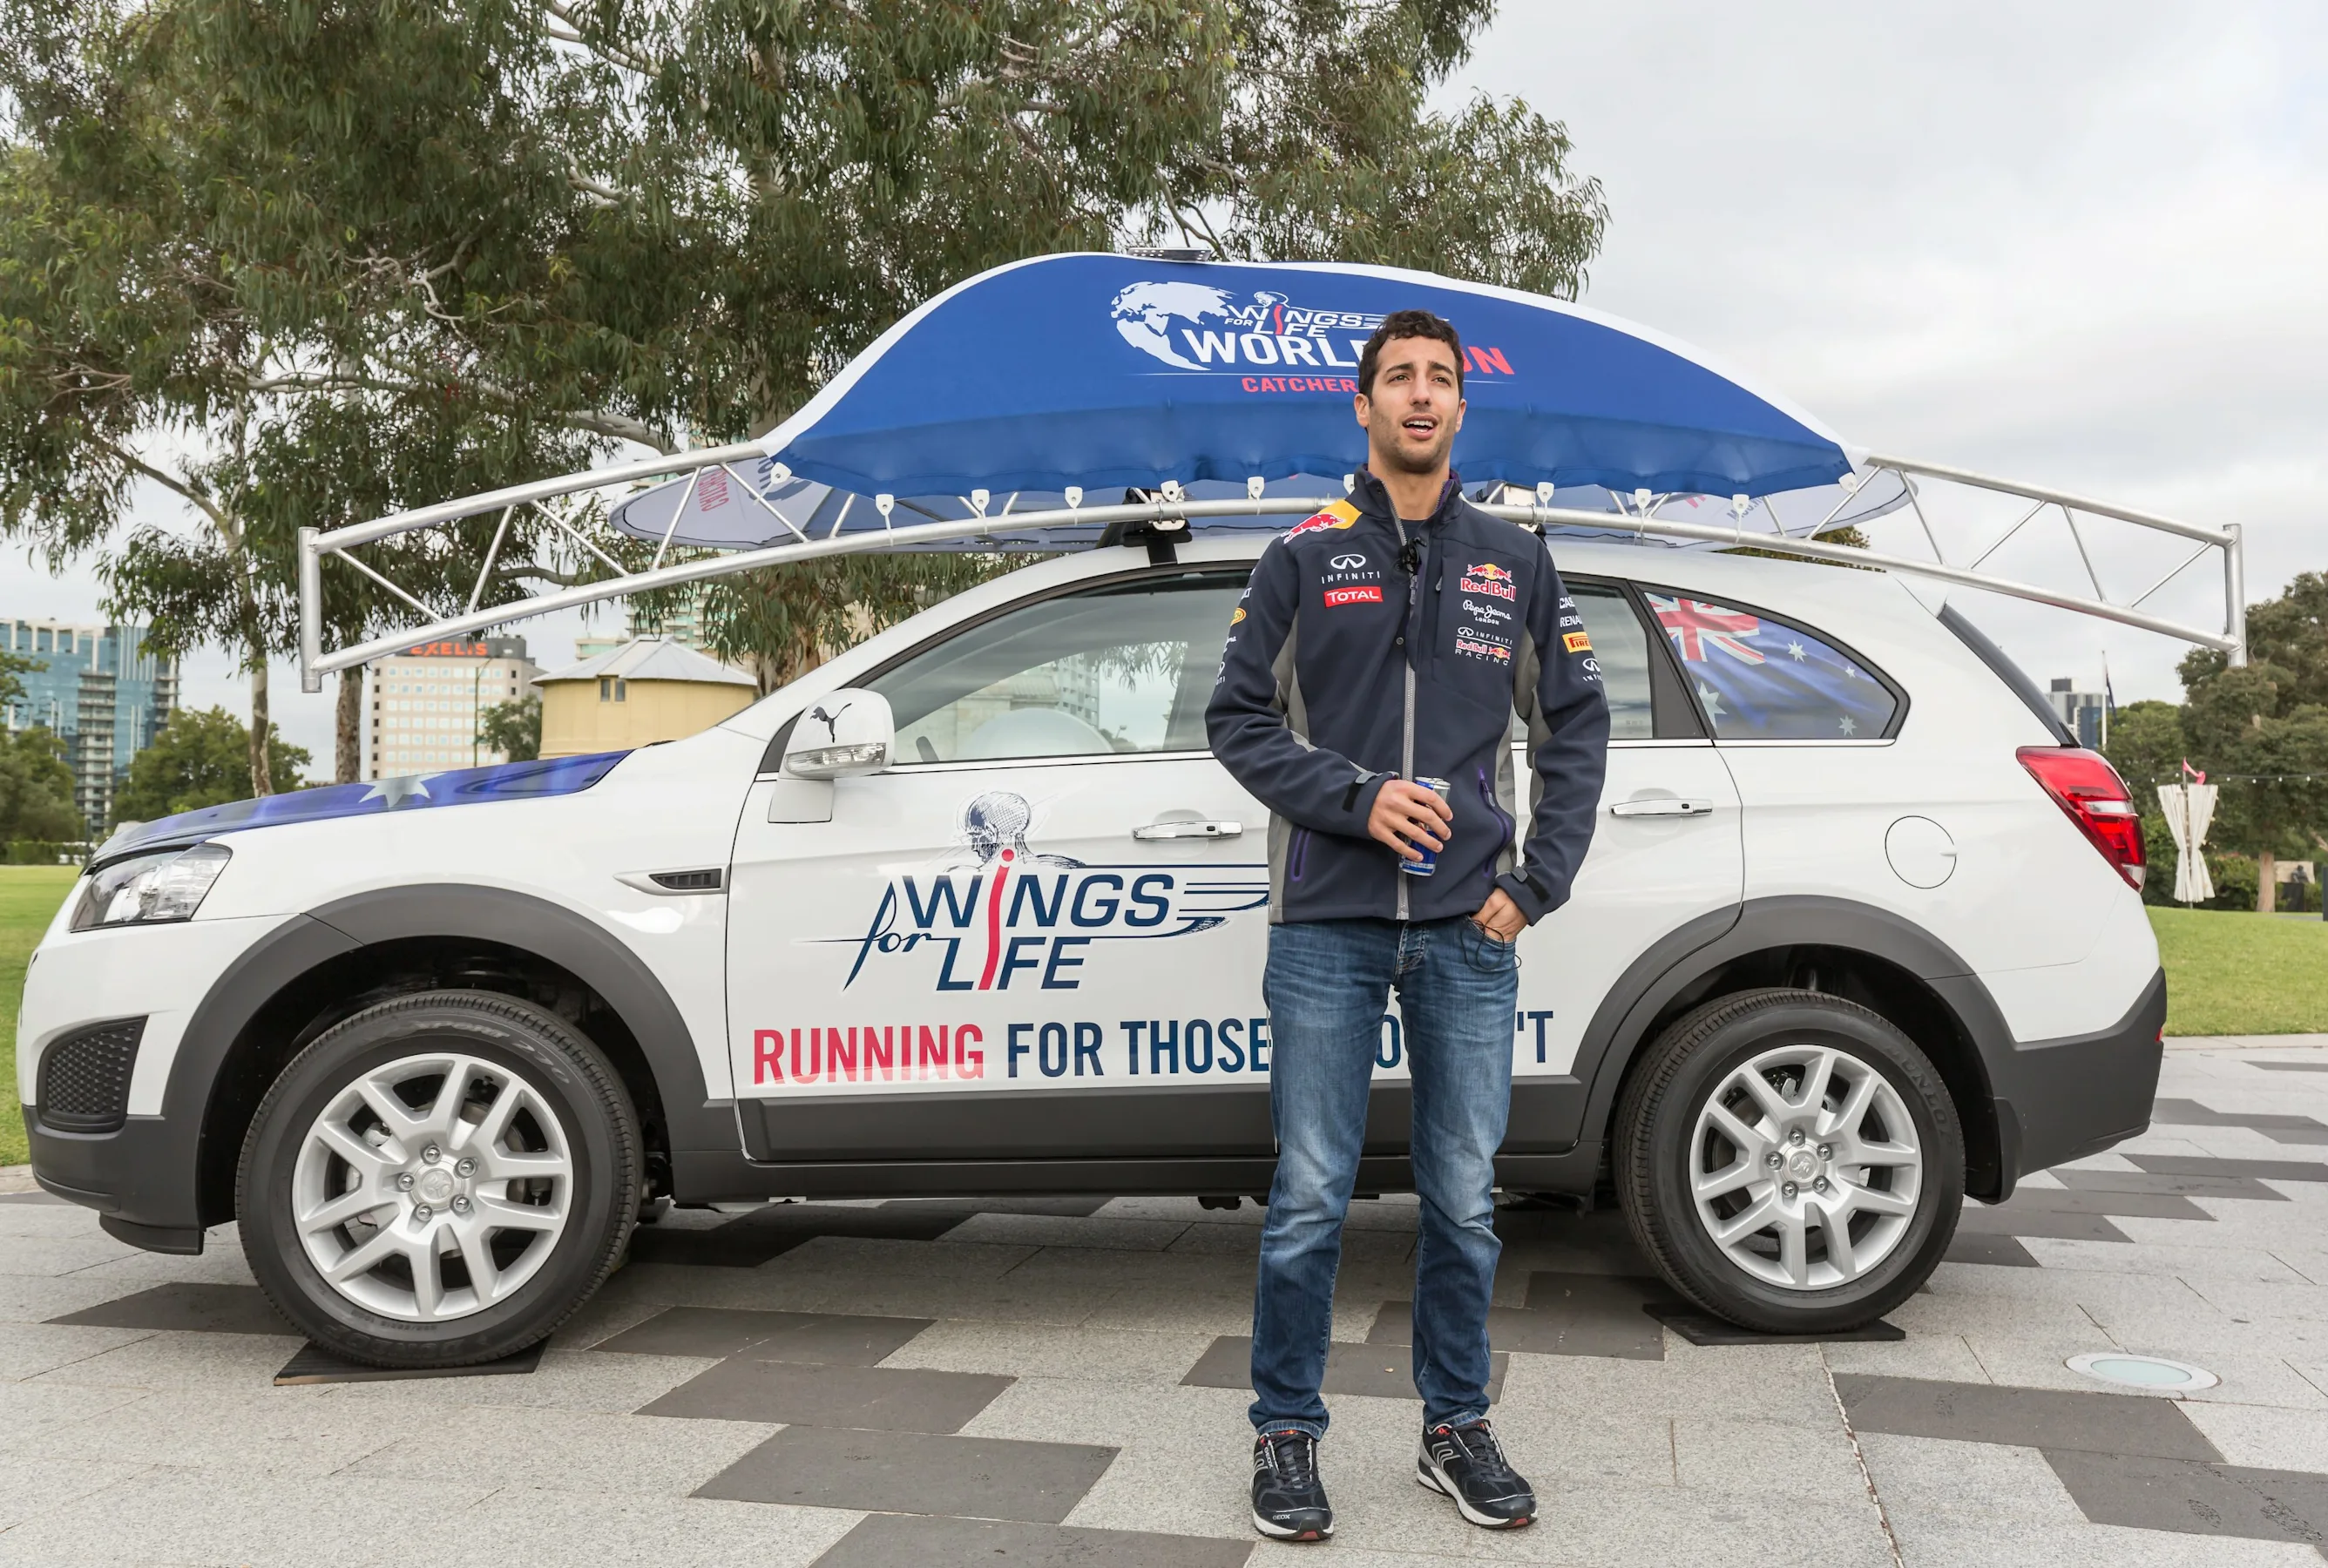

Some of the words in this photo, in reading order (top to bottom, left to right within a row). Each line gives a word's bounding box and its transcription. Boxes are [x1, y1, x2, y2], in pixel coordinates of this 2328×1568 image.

[1224, 317, 1254, 327] FOR
[1227, 303, 1363, 328] WINGS
[1253, 321, 1330, 338] LIFE
[1242, 377, 1359, 393] CATCHER
[1321, 571, 1380, 585] INFINITI
[1326, 590, 1379, 603] TOTAL
[1460, 578, 1490, 594] Red
[1491, 580, 1516, 602] Bull
[1463, 599, 1485, 616] Pepe
[1484, 605, 1512, 619] Jeans
[1560, 597, 1575, 609] CAS
[1475, 617, 1499, 625] LONDON
[1560, 615, 1583, 627] RENA
[1476, 631, 1513, 645] INFINITI
[1568, 635, 1591, 648] PIRE
[410, 641, 487, 657] EXELIS
[1457, 639, 1472, 651] Red
[1472, 642, 1488, 654] Bull
[1455, 648, 1509, 666] RACING
[902, 849, 1174, 929] WINGS
[843, 880, 932, 991] for
[936, 936, 1092, 990] LIFE
[753, 1024, 984, 1085] RUNNING
[1008, 1022, 1103, 1078] FOR
[1120, 1017, 1271, 1075] THOSE
[1264, 1447, 1273, 1469] GEOX
